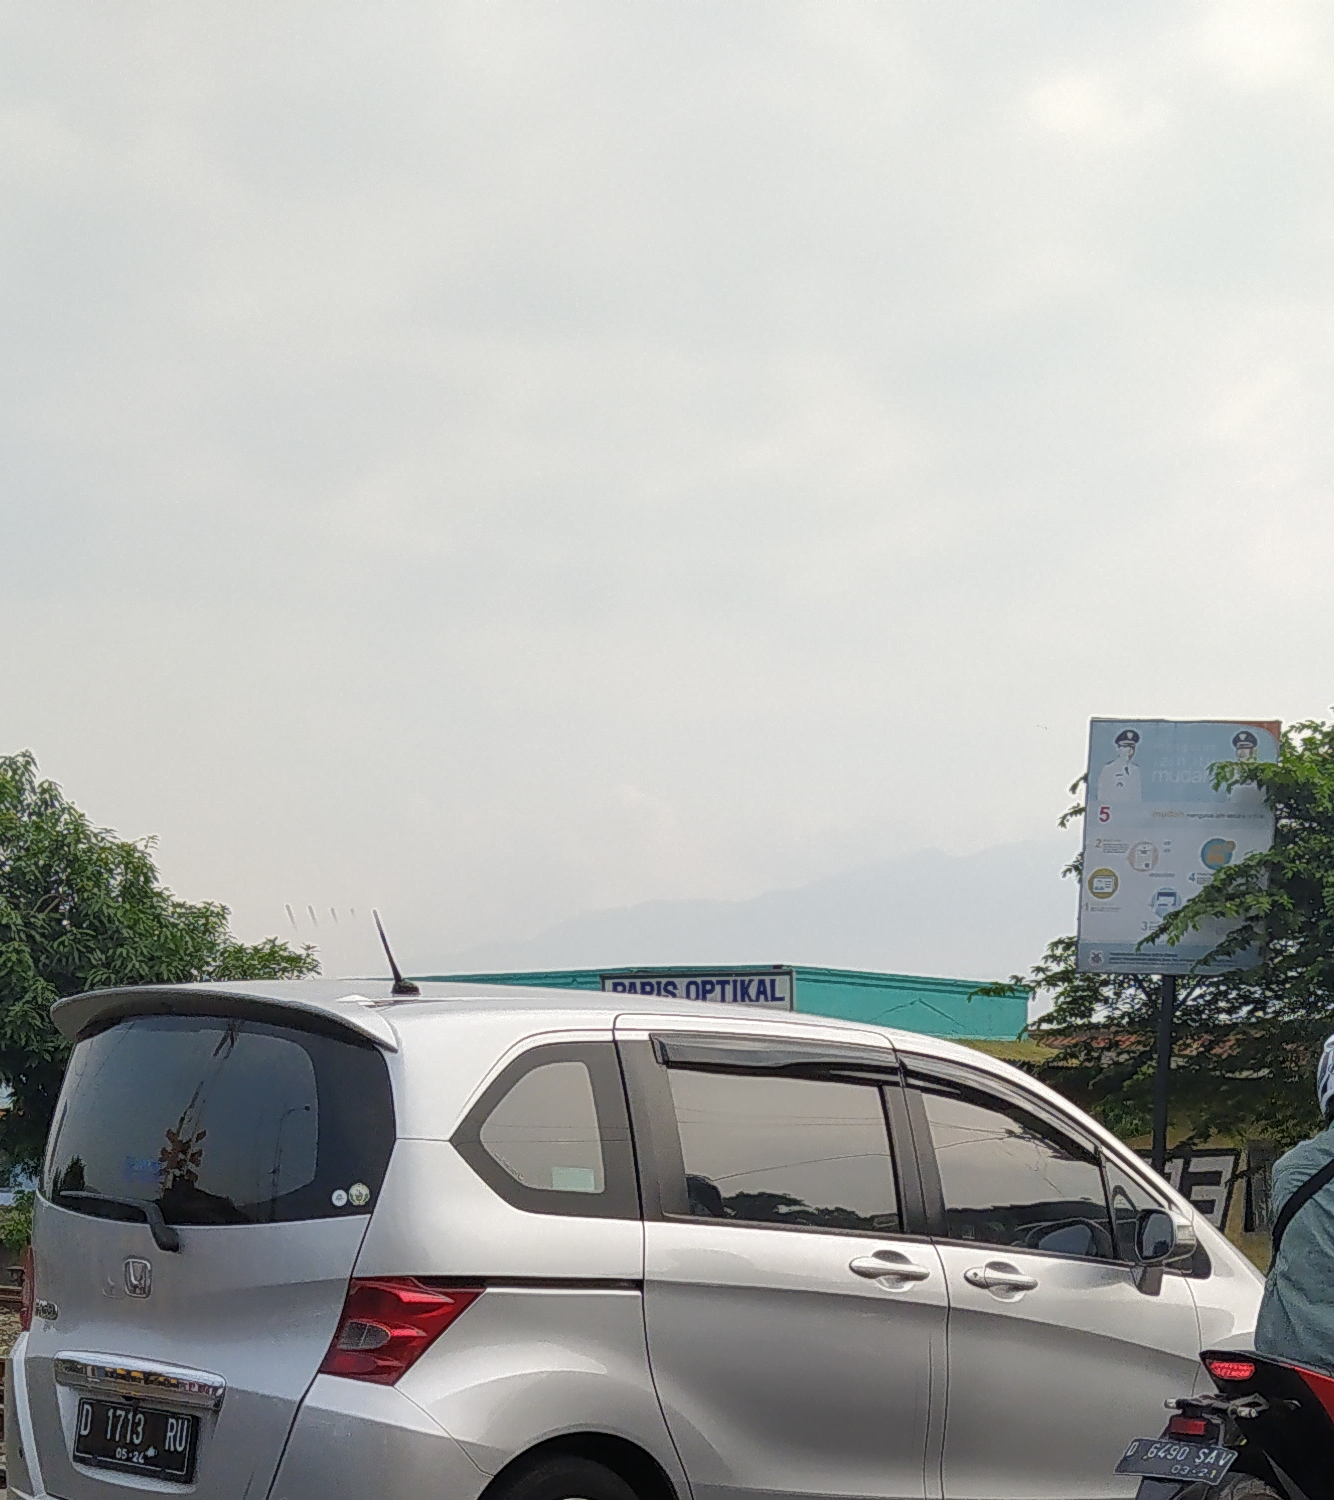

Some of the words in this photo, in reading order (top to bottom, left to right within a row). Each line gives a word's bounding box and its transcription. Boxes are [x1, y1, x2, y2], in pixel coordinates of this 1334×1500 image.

[1098, 805, 1111, 823] 5
[685, 978, 786, 1003] OPTIKAL
[79, 1403, 92, 1436] D
[106, 1408, 145, 1445] 1713
[164, 1417, 188, 1452] RU
[1126, 1441, 1140, 1457] D
[1147, 1443, 1190, 1461] 6490
[1194, 1448, 1233, 1466] SAV
